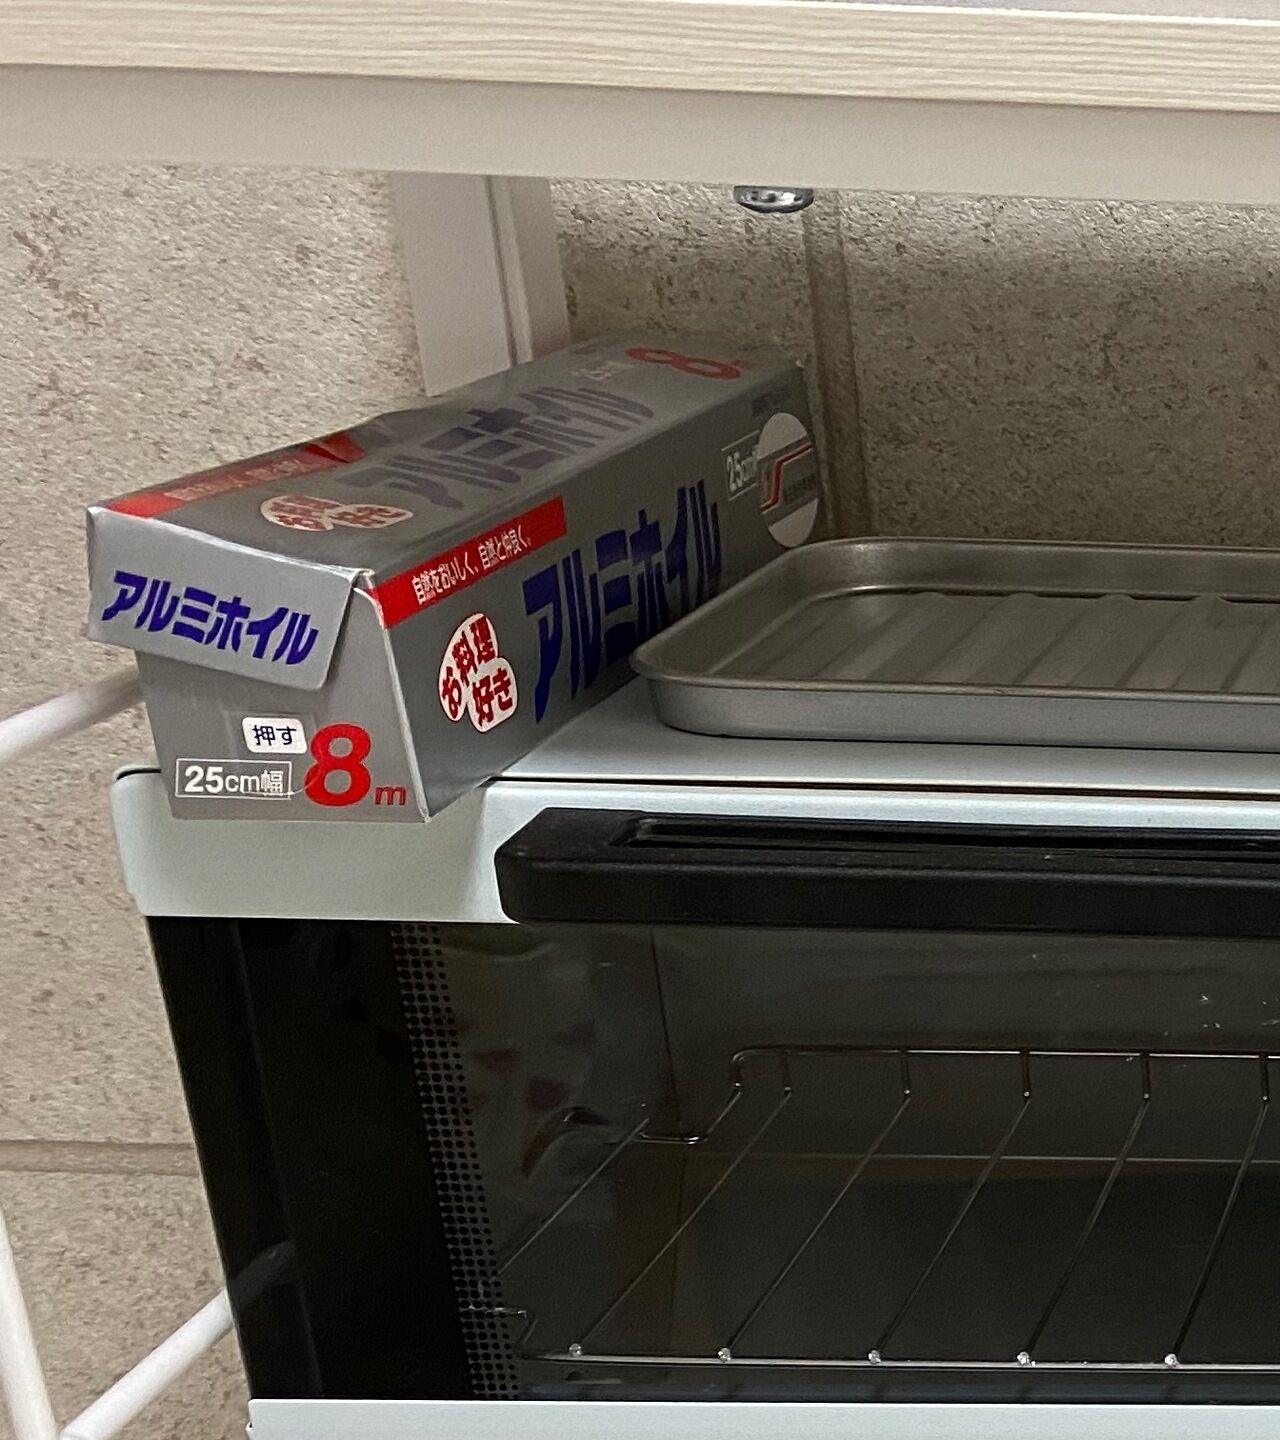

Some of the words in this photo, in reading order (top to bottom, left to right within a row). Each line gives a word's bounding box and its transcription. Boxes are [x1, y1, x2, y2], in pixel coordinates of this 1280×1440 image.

[333, 386, 654, 511] アルミホイル
[101, 569, 320, 665] アルミホイル
[522, 478, 722, 724] アルミホイル
[252, 724, 297, 746] 押す
